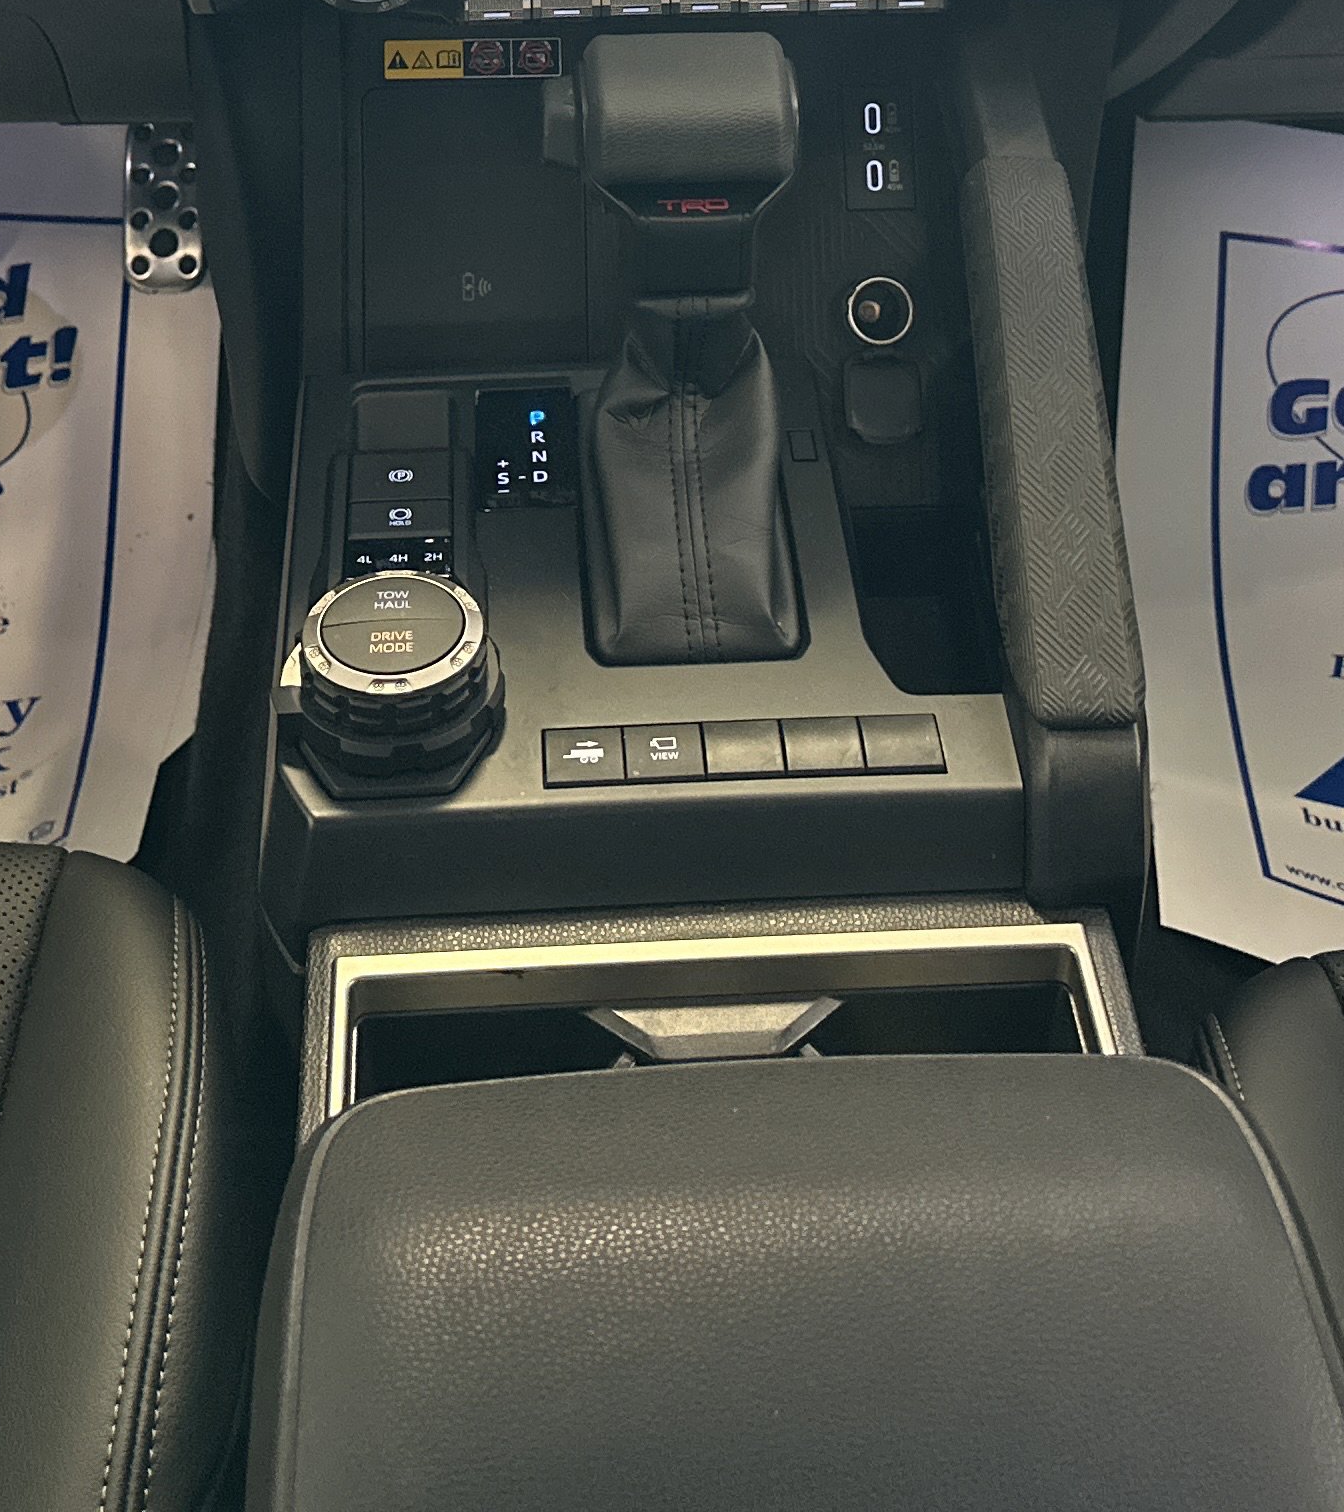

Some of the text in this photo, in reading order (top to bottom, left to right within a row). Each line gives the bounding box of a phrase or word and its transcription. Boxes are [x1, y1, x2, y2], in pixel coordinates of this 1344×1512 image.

[657, 197, 729, 214] TRD
[529, 410, 545, 425] P
[530, 431, 546, 443] R
[531, 451, 548, 462] N
[497, 472, 510, 484] S
[532, 471, 549, 483] D
[388, 519, 412, 527] HOLD
[356, 552, 443, 565] 4L 4H 2H
[376, 590, 409, 600] TOW
[373, 600, 412, 610] HAUL
[370, 630, 414, 642] DRIVE
[369, 642, 414, 654] MODE
[649, 750, 680, 761] VIEW
